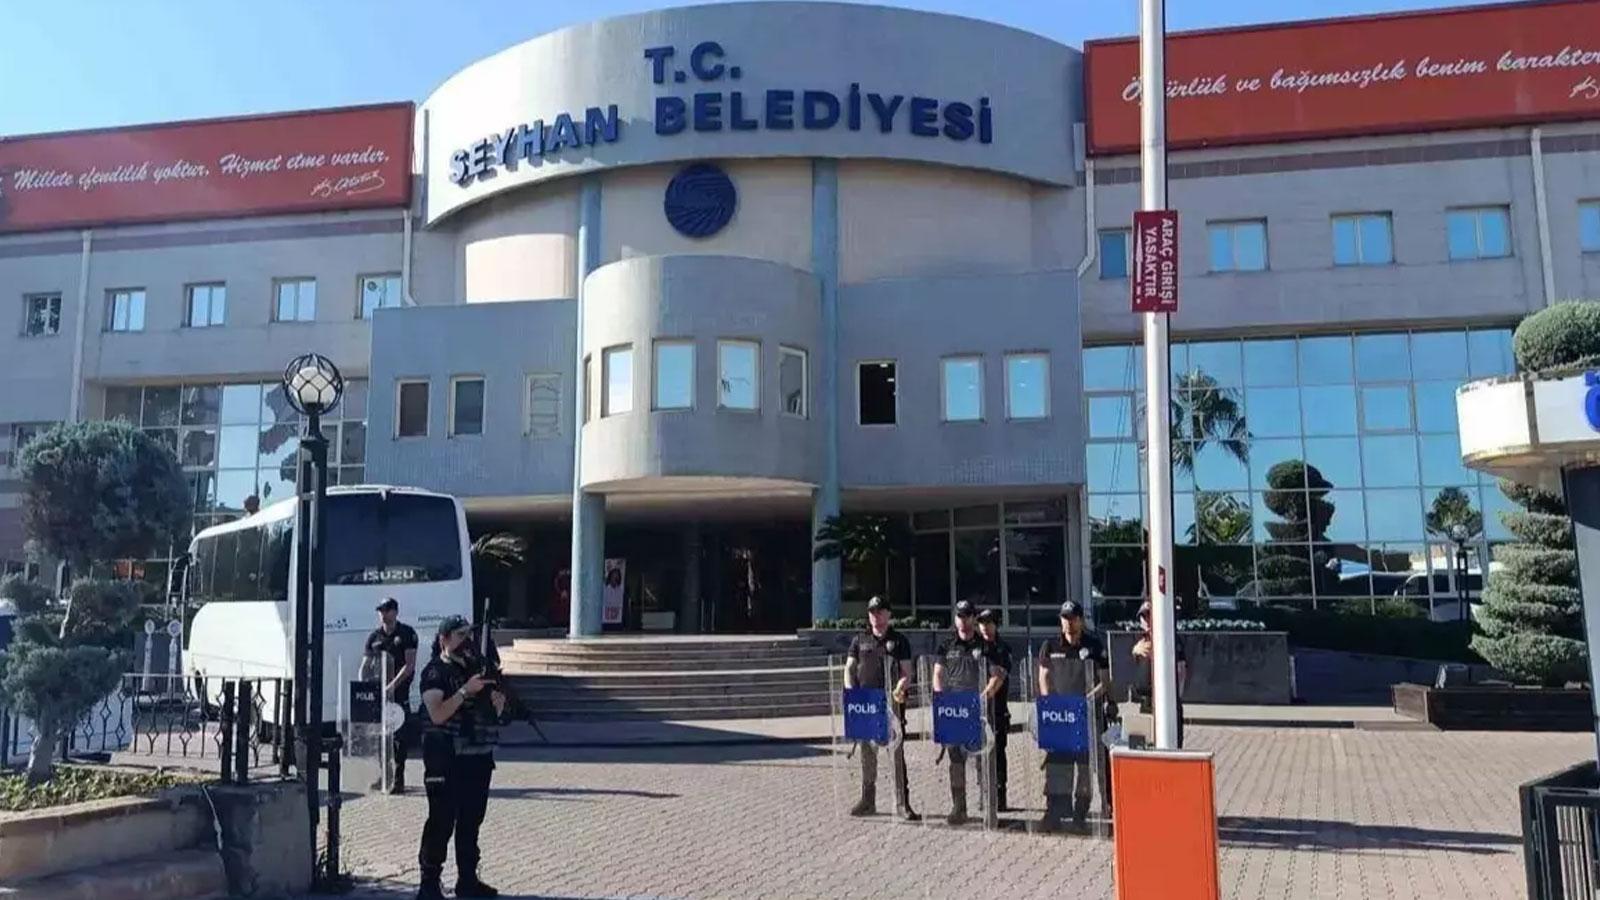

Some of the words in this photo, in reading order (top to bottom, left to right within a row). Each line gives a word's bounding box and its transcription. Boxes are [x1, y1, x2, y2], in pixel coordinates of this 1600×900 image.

[644, 41, 742, 84] T.C.
[1122, 75, 1227, 106] Öürlük
[1236, 76, 1262, 92] ve
[1270, 60, 1408, 93] bağımsızlık
[1416, 57, 1487, 78] benim
[450, 104, 619, 184] SEYHAN
[655, 83, 993, 144] BELEDİYESİ
[14, 169, 74, 191] Millete
[78, 160, 150, 191] efendilik
[219, 153, 283, 179] Hizmet
[286, 152, 326, 171] etme
[1159, 218, 1174, 257] ARAÇ
[1158, 261, 1176, 304] GİRİŞİ
[363, 569, 414, 581] ISUZU
[847, 702, 877, 715] POLİS
[937, 704, 970, 719] POLİS
[1041, 710, 1076, 724] POLİS
